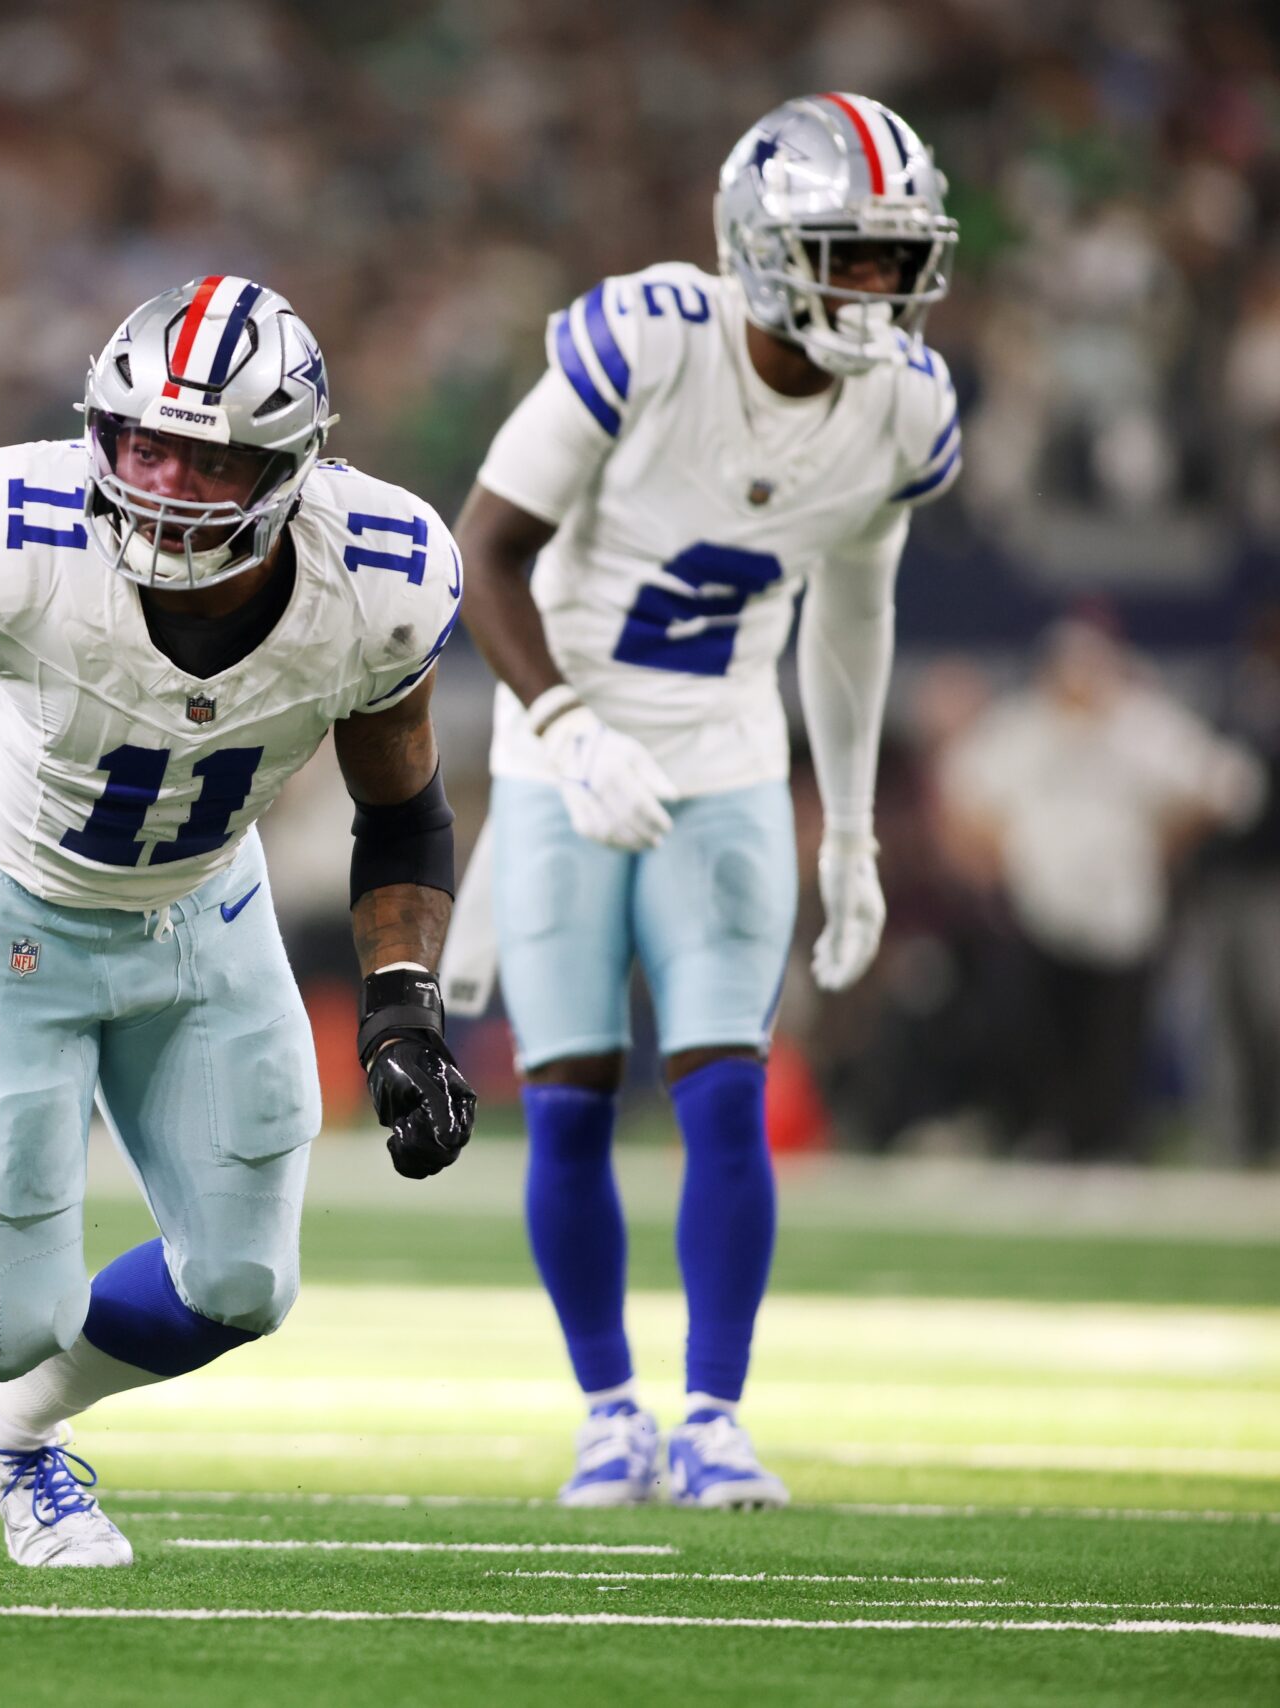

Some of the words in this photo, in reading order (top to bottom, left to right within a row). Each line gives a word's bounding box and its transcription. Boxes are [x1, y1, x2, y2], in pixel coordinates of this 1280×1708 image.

[642, 281, 710, 324] 2
[160, 405, 217, 426] COWBOYS
[7, 478, 88, 550] 11
[343, 512, 428, 586] 11
[611, 540, 784, 677] 2
[59, 743, 265, 867] 11
[14, 953, 35, 970] NFL
